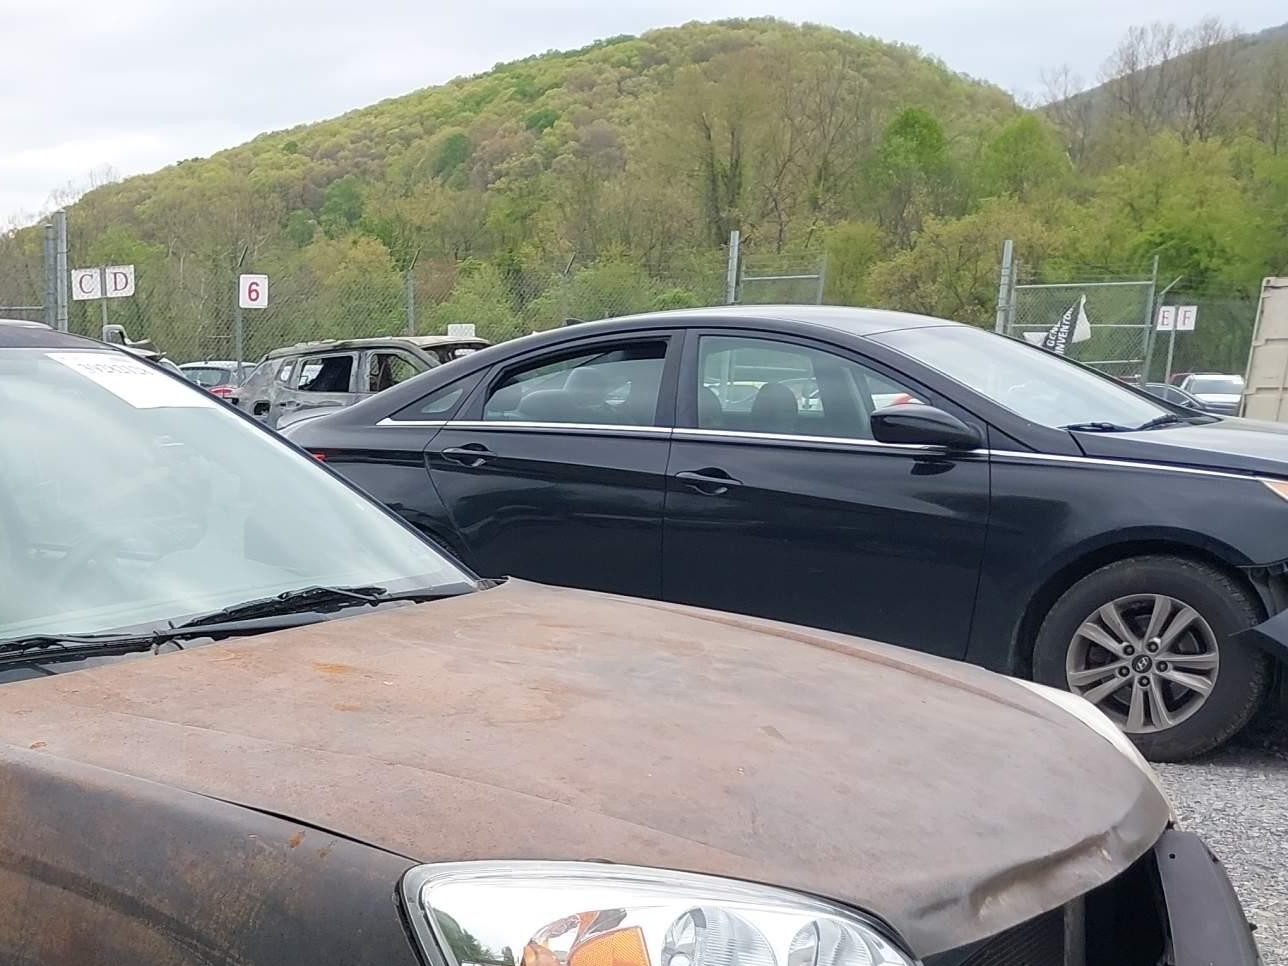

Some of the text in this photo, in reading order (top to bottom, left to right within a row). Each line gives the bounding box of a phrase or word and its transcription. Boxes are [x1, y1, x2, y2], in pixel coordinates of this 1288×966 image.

[79, 273, 94, 294] C
[111, 271, 128, 292] D
[247, 281, 260, 302] 6
[1161, 310, 1170, 326] E
[1183, 310, 1192, 326] F
